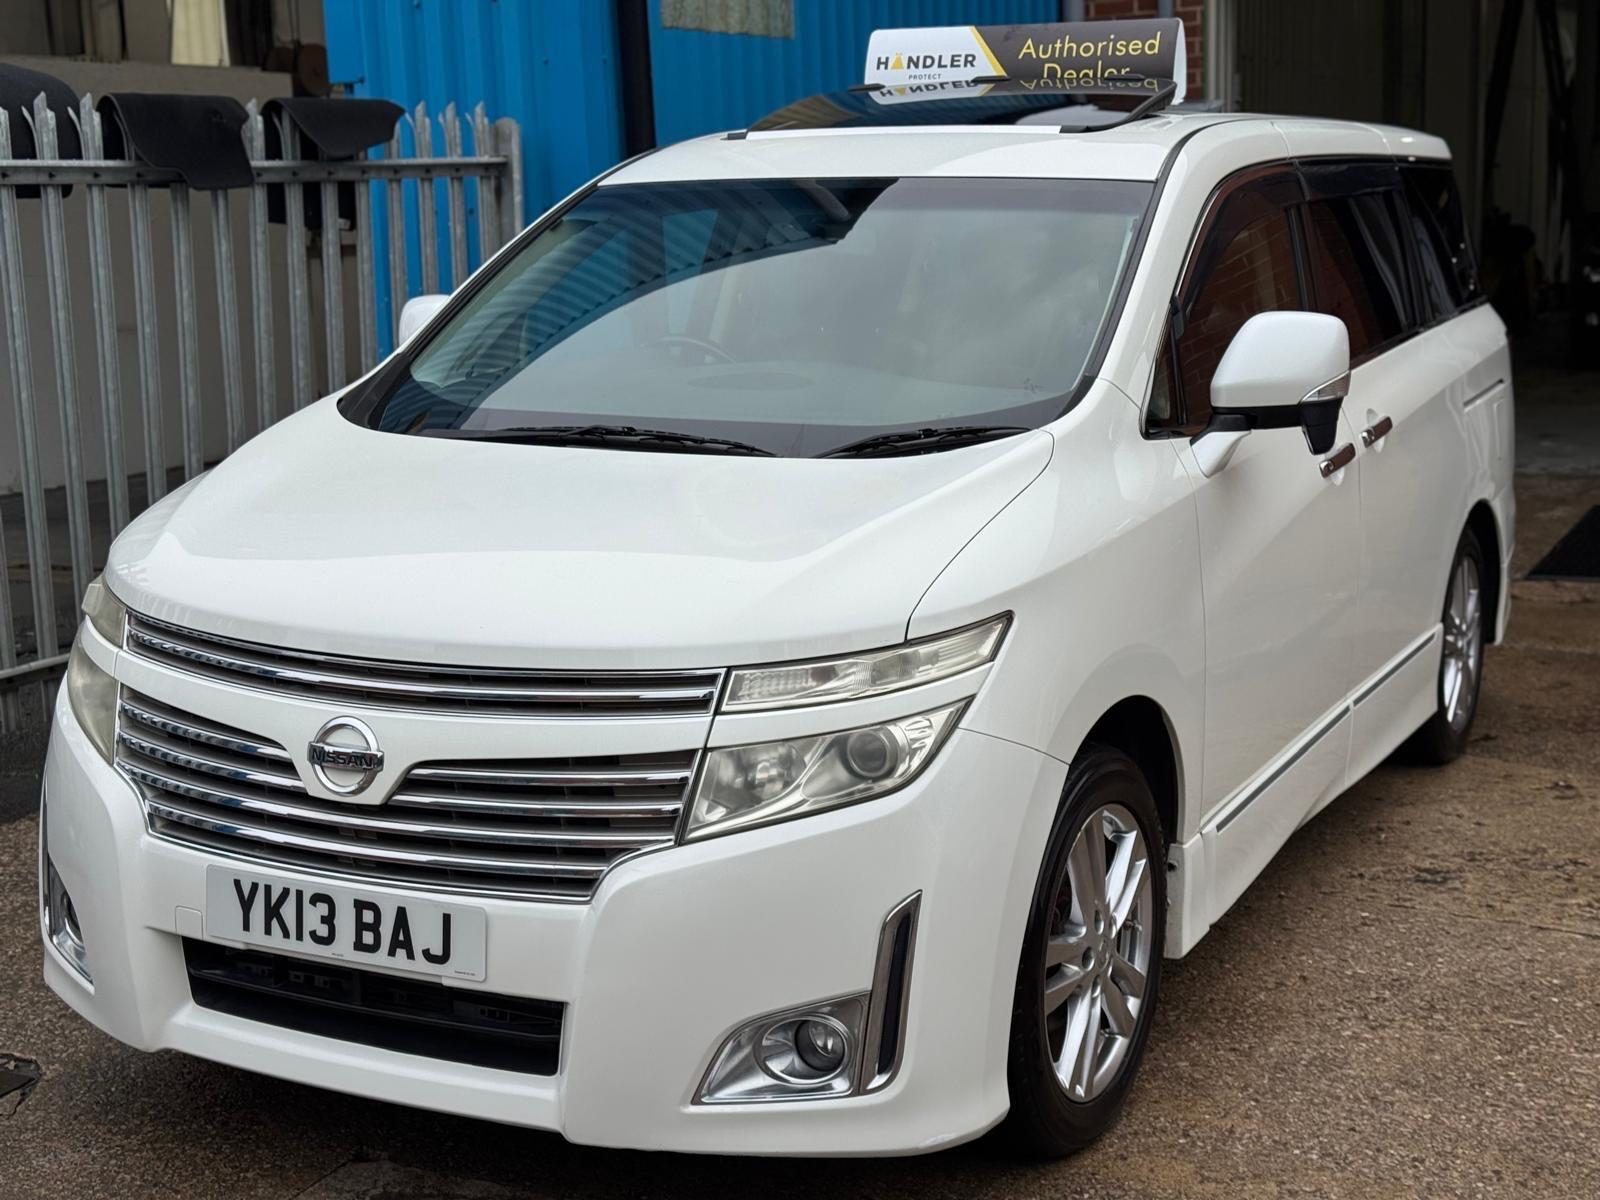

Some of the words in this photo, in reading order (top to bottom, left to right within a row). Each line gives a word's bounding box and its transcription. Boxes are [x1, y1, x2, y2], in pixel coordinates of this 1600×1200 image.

[1018, 31, 1161, 59] Authorised
[312, 747, 374, 768] NISSAN
[233, 878, 336, 946] YK13
[353, 898, 452, 965] BAJ
